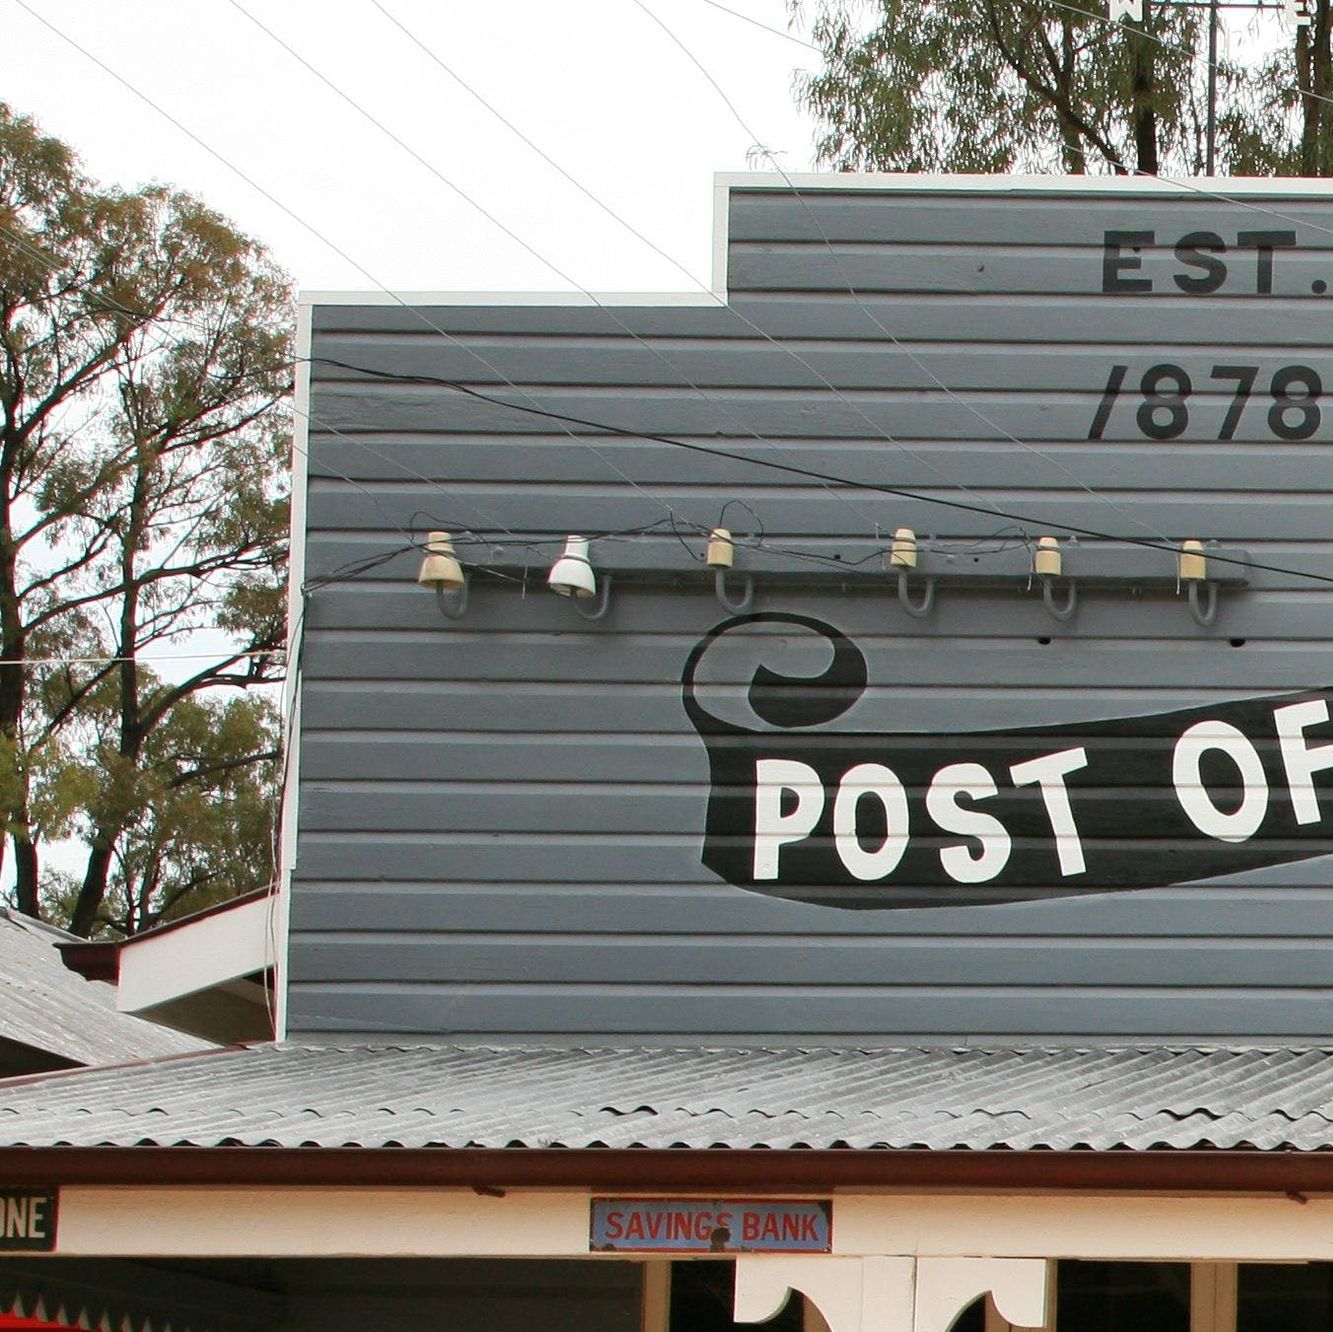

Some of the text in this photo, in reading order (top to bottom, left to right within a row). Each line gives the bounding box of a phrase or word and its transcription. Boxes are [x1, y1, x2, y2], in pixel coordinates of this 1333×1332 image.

[1102, 230, 1327, 294] EST.
[1087, 363, 1323, 440] 1878
[752, 746, 1088, 884] POST
[742, 1212, 819, 1242] BANK
